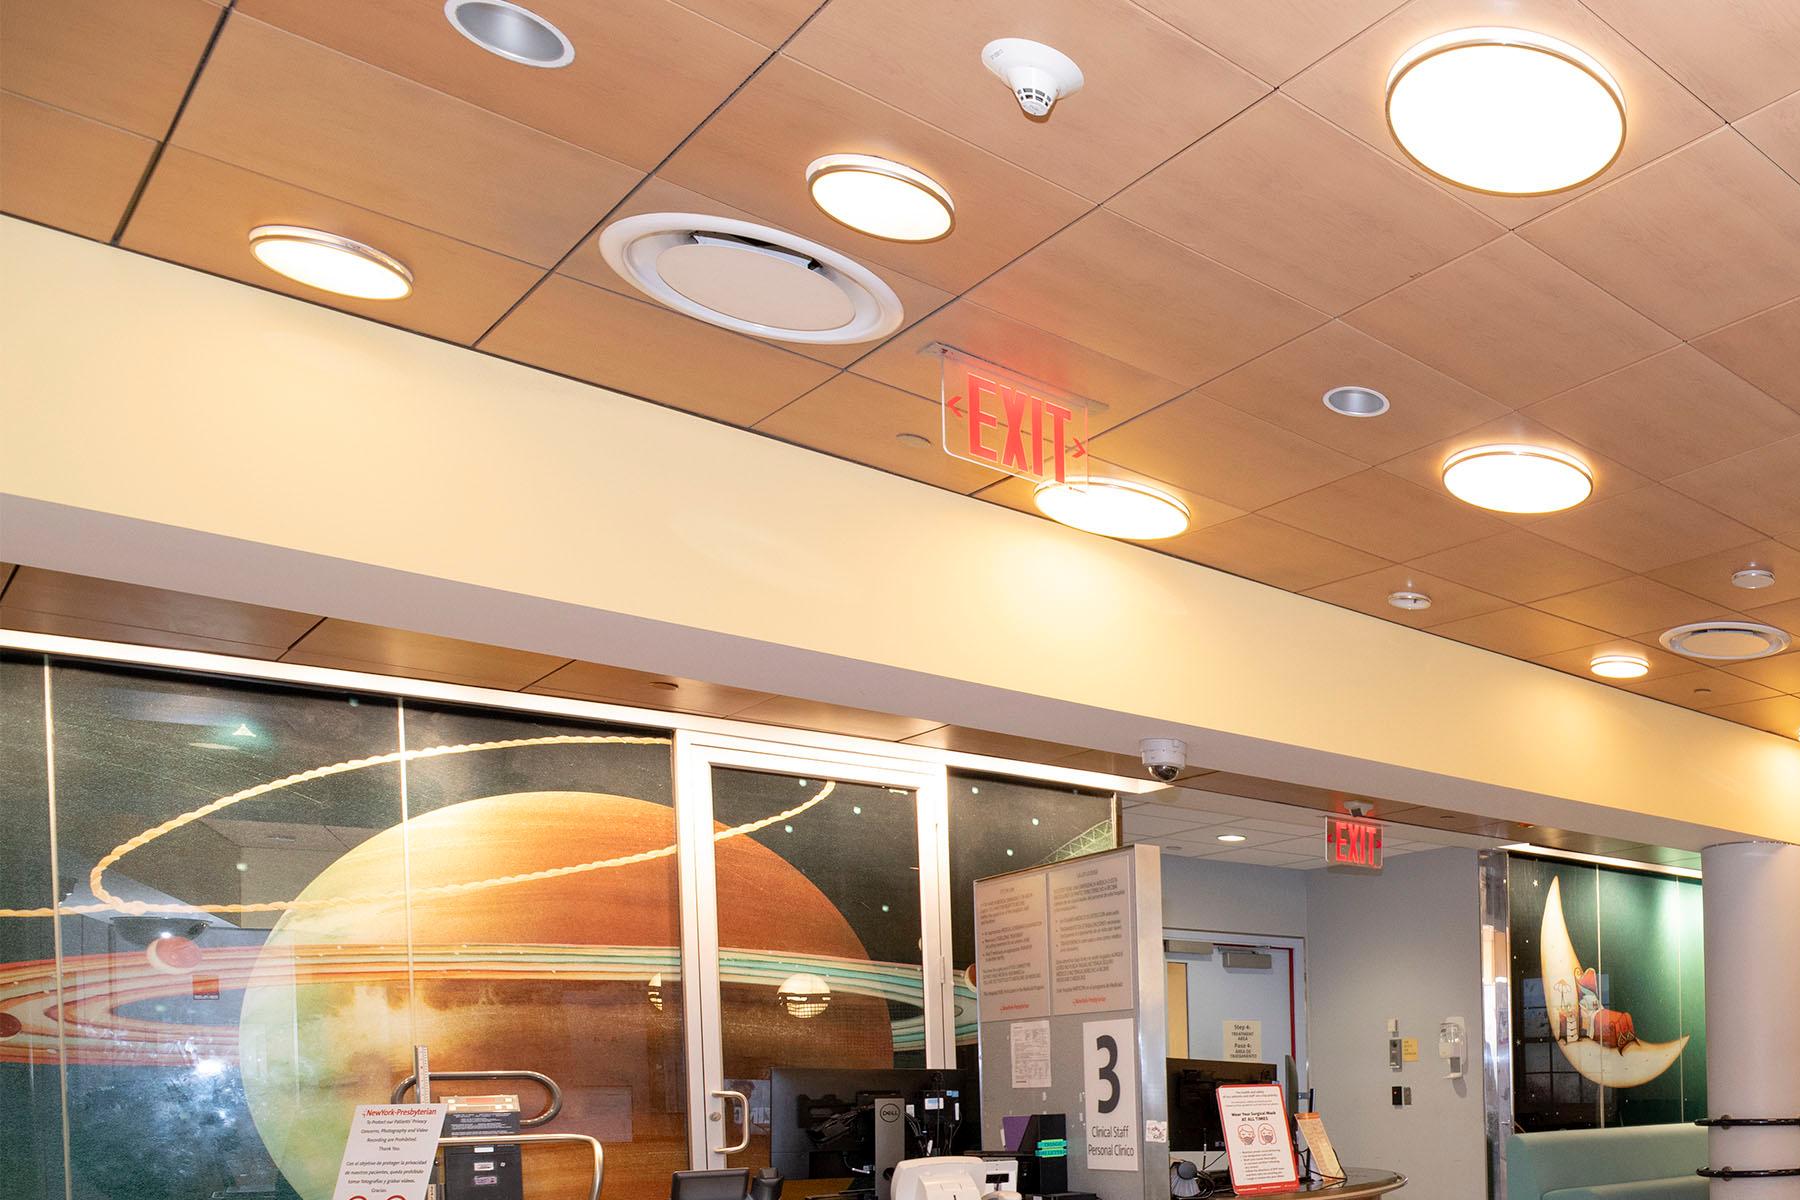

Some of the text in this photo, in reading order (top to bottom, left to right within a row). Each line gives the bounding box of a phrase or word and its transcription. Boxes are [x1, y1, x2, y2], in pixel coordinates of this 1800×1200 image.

[967, 372, 1073, 484] EXIT
[1336, 822, 1376, 865] EXIT
[1096, 1035, 1120, 1114] 3
[367, 1108, 436, 1117] NewYork-Presbyterian
[1091, 1125, 1129, 1138] Clinical Staff
[1088, 1144, 1113, 1156] Personal
